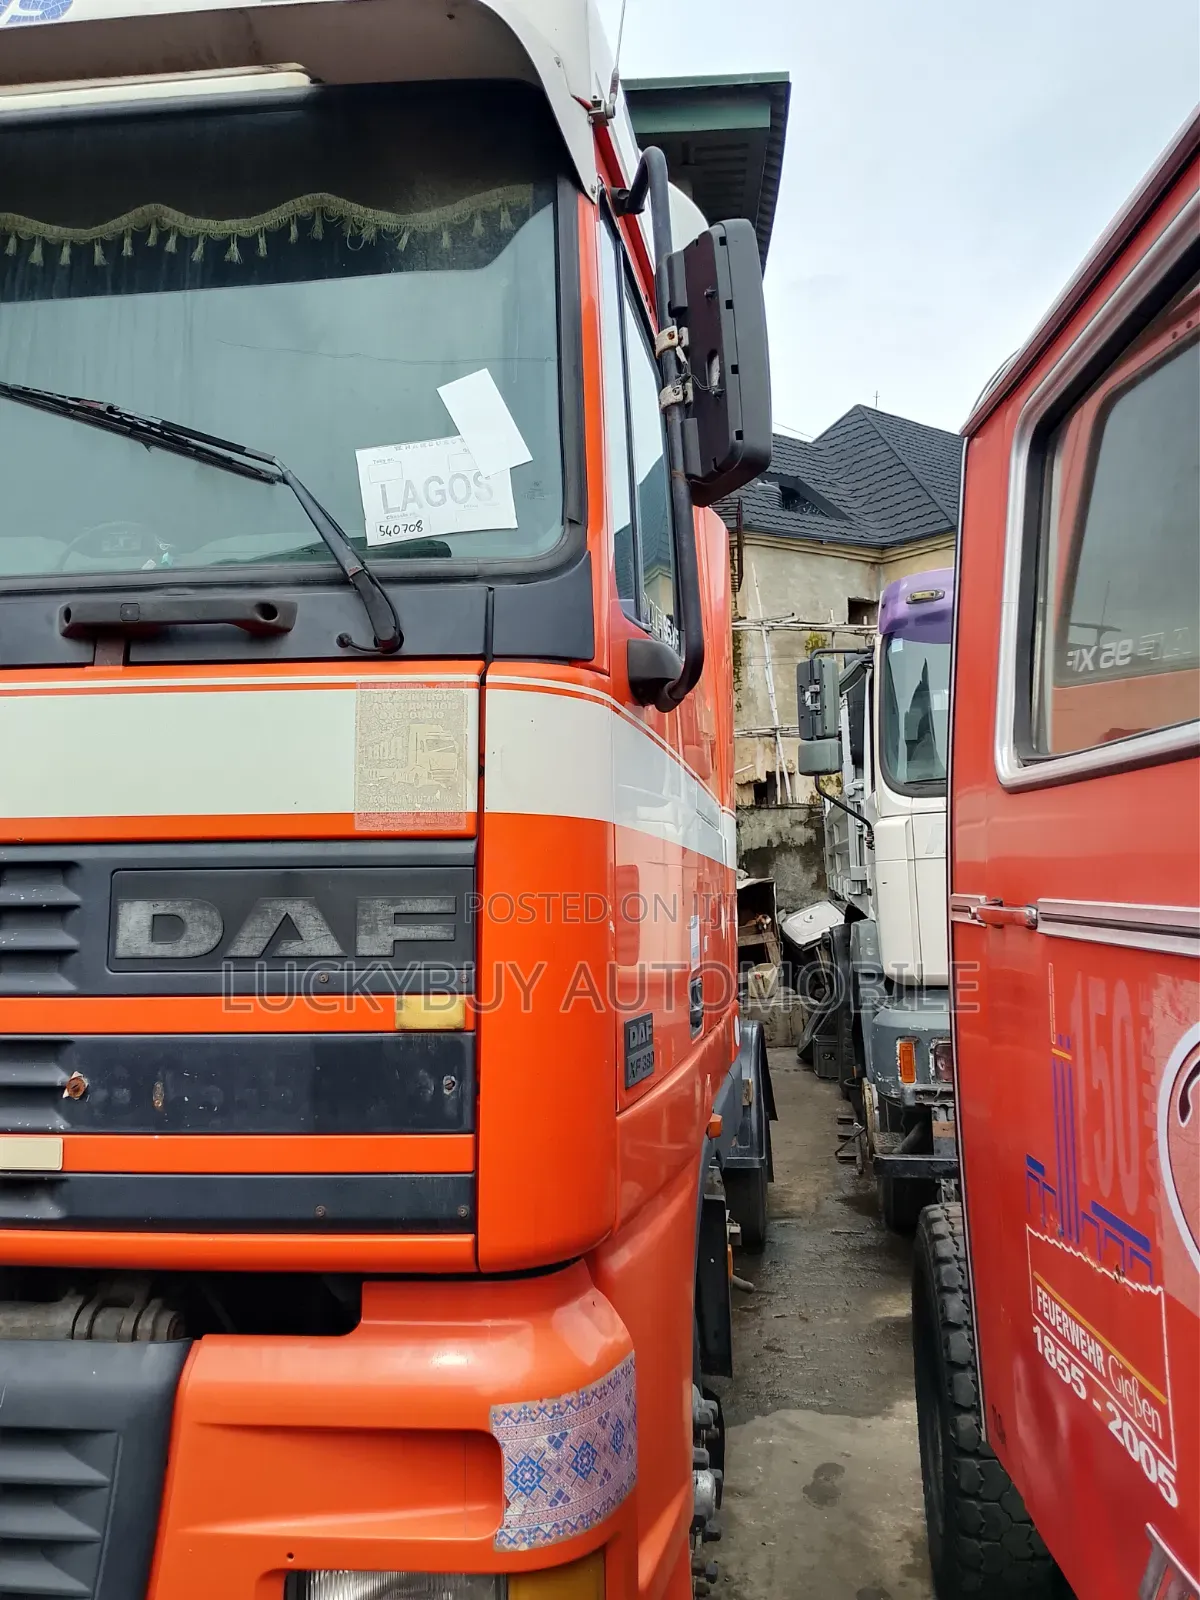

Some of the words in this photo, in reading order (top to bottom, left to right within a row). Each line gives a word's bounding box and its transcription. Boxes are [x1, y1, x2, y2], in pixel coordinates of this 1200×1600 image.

[380, 471, 494, 515] LAGOS
[379, 520, 424, 537] 540708
[115, 895, 457, 960] DAF
[629, 1019, 653, 1049] DAF
[1036, 1285, 1106, 1377] FEUERWEHR
[1108, 1354, 1163, 1439] Gießen
[1033, 1325, 1087, 1400] 1855
[1106, 1401, 1179, 1508] 2005
